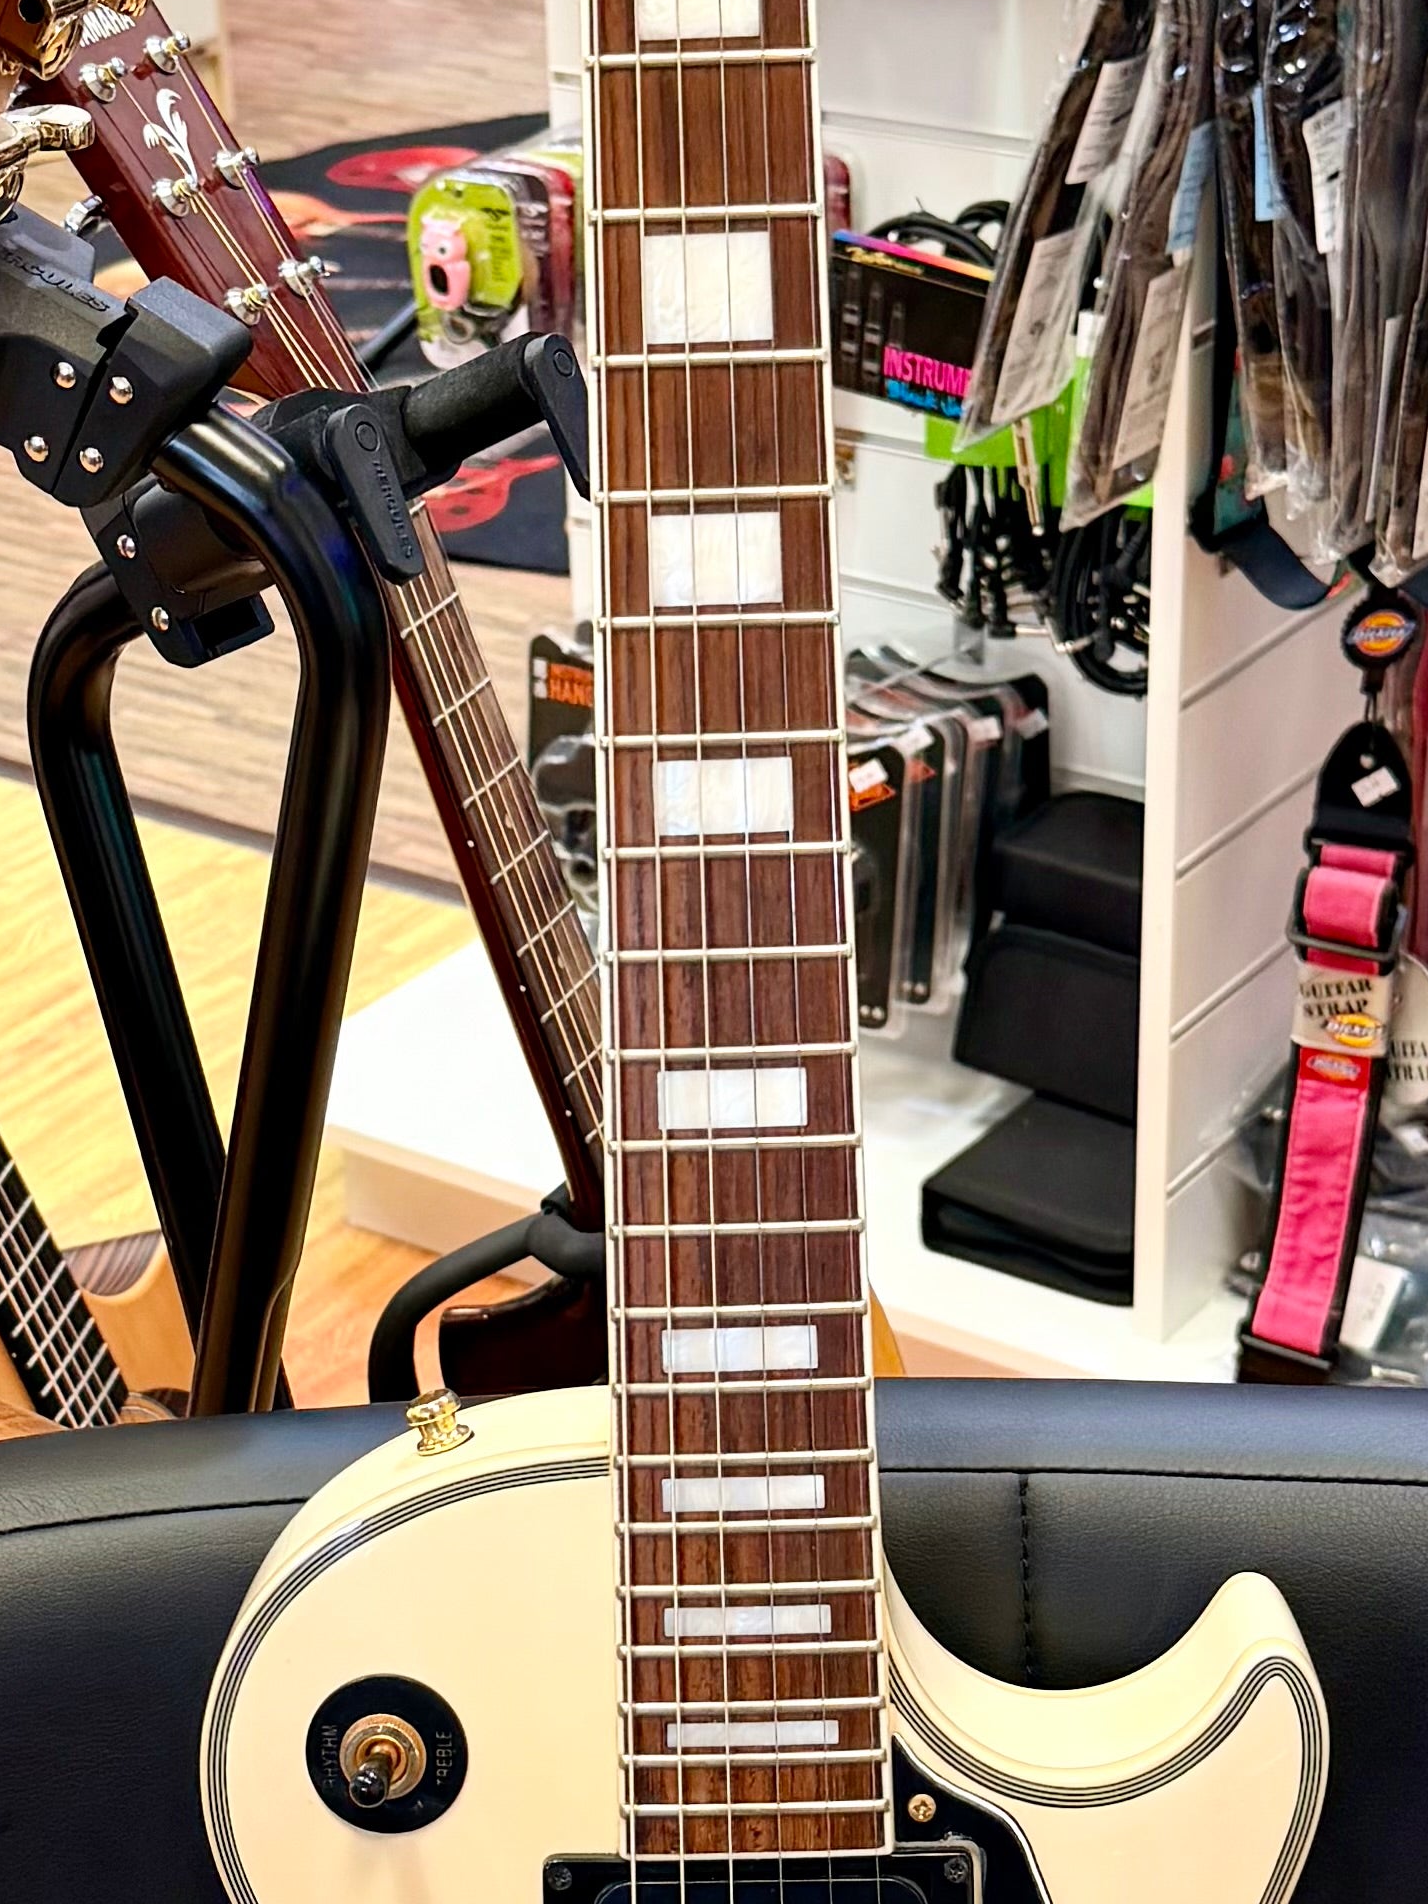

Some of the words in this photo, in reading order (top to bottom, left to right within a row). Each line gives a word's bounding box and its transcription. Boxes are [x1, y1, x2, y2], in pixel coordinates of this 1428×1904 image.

[80, 3, 136, 48] AMAHA
[884, 345, 972, 399] INSTRUM
[1299, 978, 1373, 999] GUITAR
[1304, 999, 1369, 1017] STRAP
[320, 1723, 339, 1790] RHYTHM
[436, 1729, 453, 1787] TREBLE
